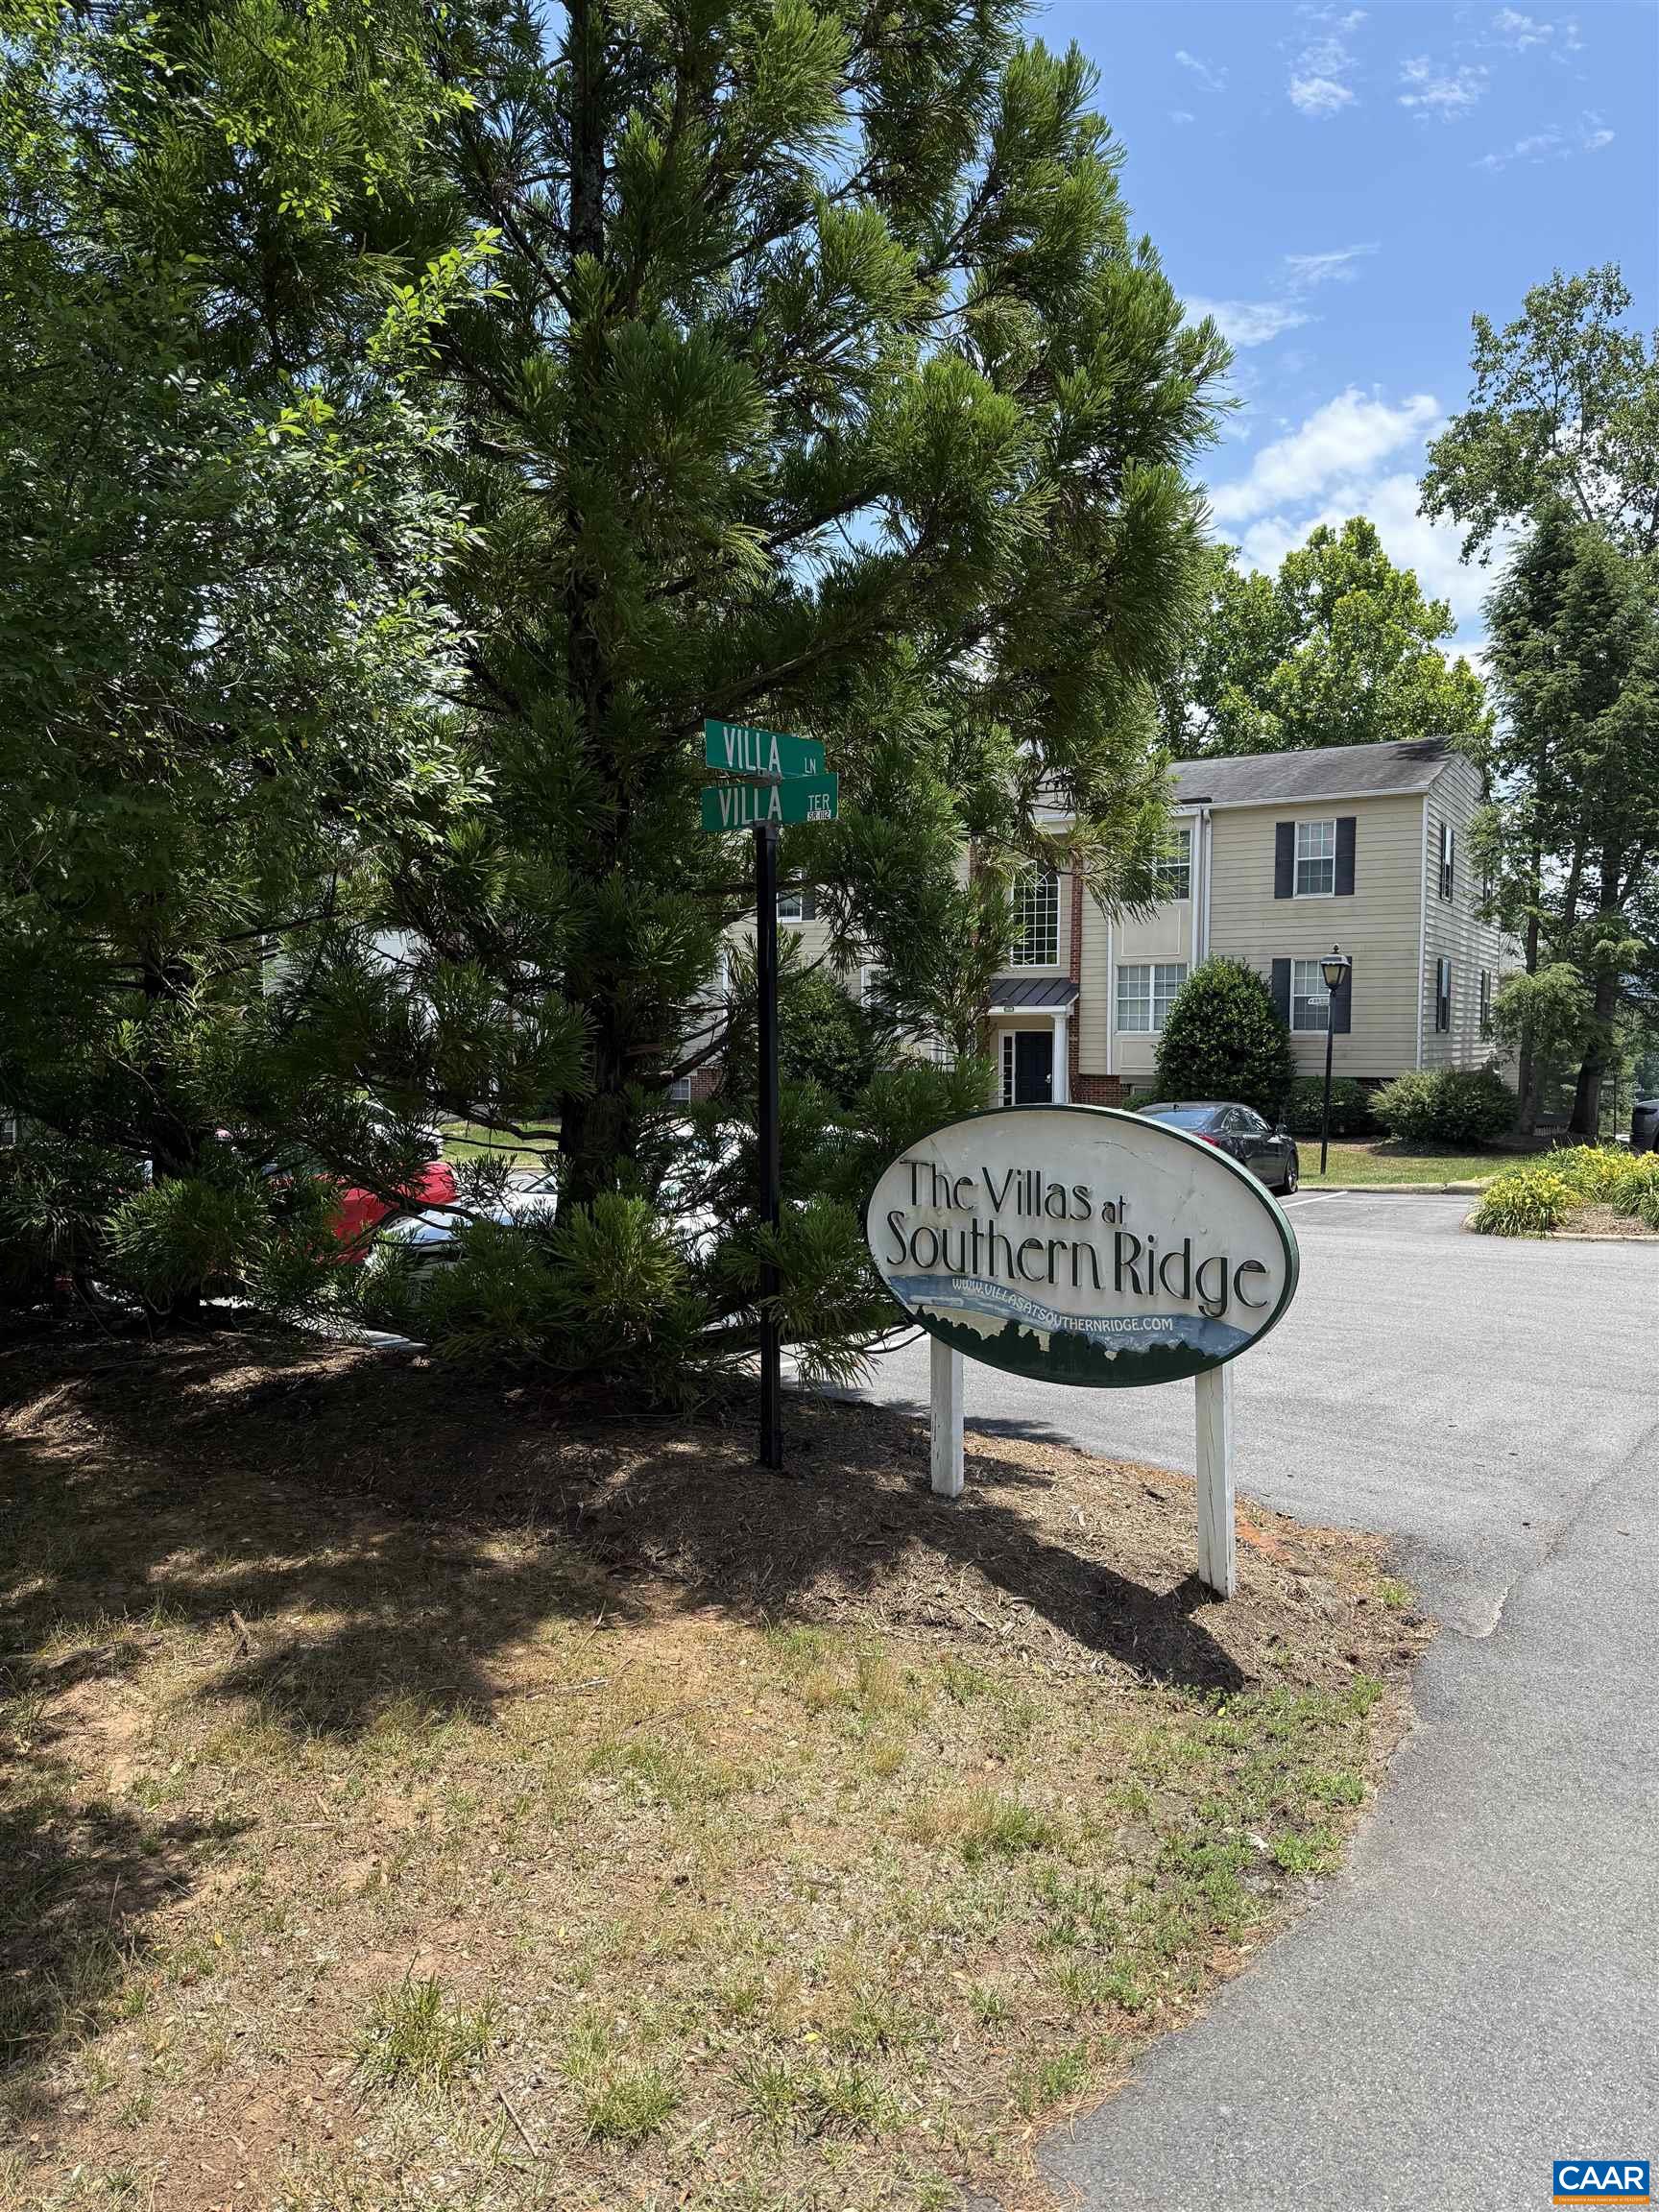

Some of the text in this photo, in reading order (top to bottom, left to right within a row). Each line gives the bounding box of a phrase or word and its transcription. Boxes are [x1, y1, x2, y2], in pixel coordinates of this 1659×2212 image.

[723, 726, 817, 776] VILLA LN
[718, 784, 830, 827] VILLA TER
[899, 1160, 1128, 1225] The Villas at
[886, 1210, 1268, 1317] Southern Ridge
